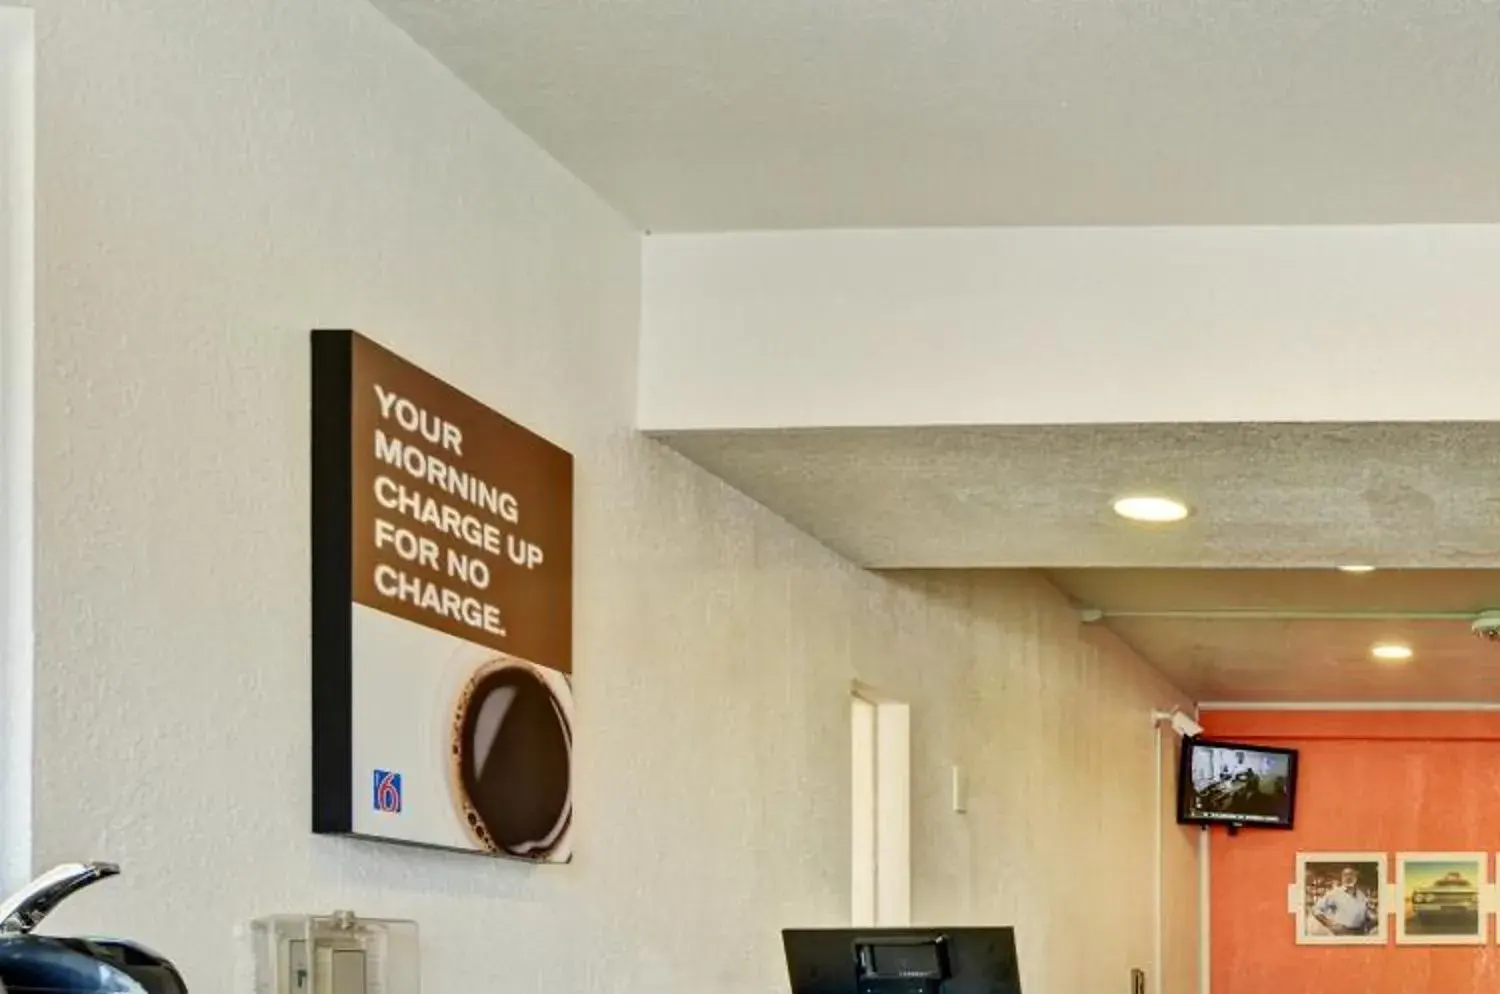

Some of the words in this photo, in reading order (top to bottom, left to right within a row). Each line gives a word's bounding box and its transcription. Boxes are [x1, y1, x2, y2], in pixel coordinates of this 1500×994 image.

[373, 384, 463, 456] YOUR
[374, 429, 519, 524] MORNING
[374, 476, 501, 556] CHARGE
[507, 534, 544, 569] UP
[374, 519, 440, 571] FOR
[447, 548, 490, 589] NO
[374, 564, 507, 637] CHARGE.
[378, 771, 398, 812] 6
